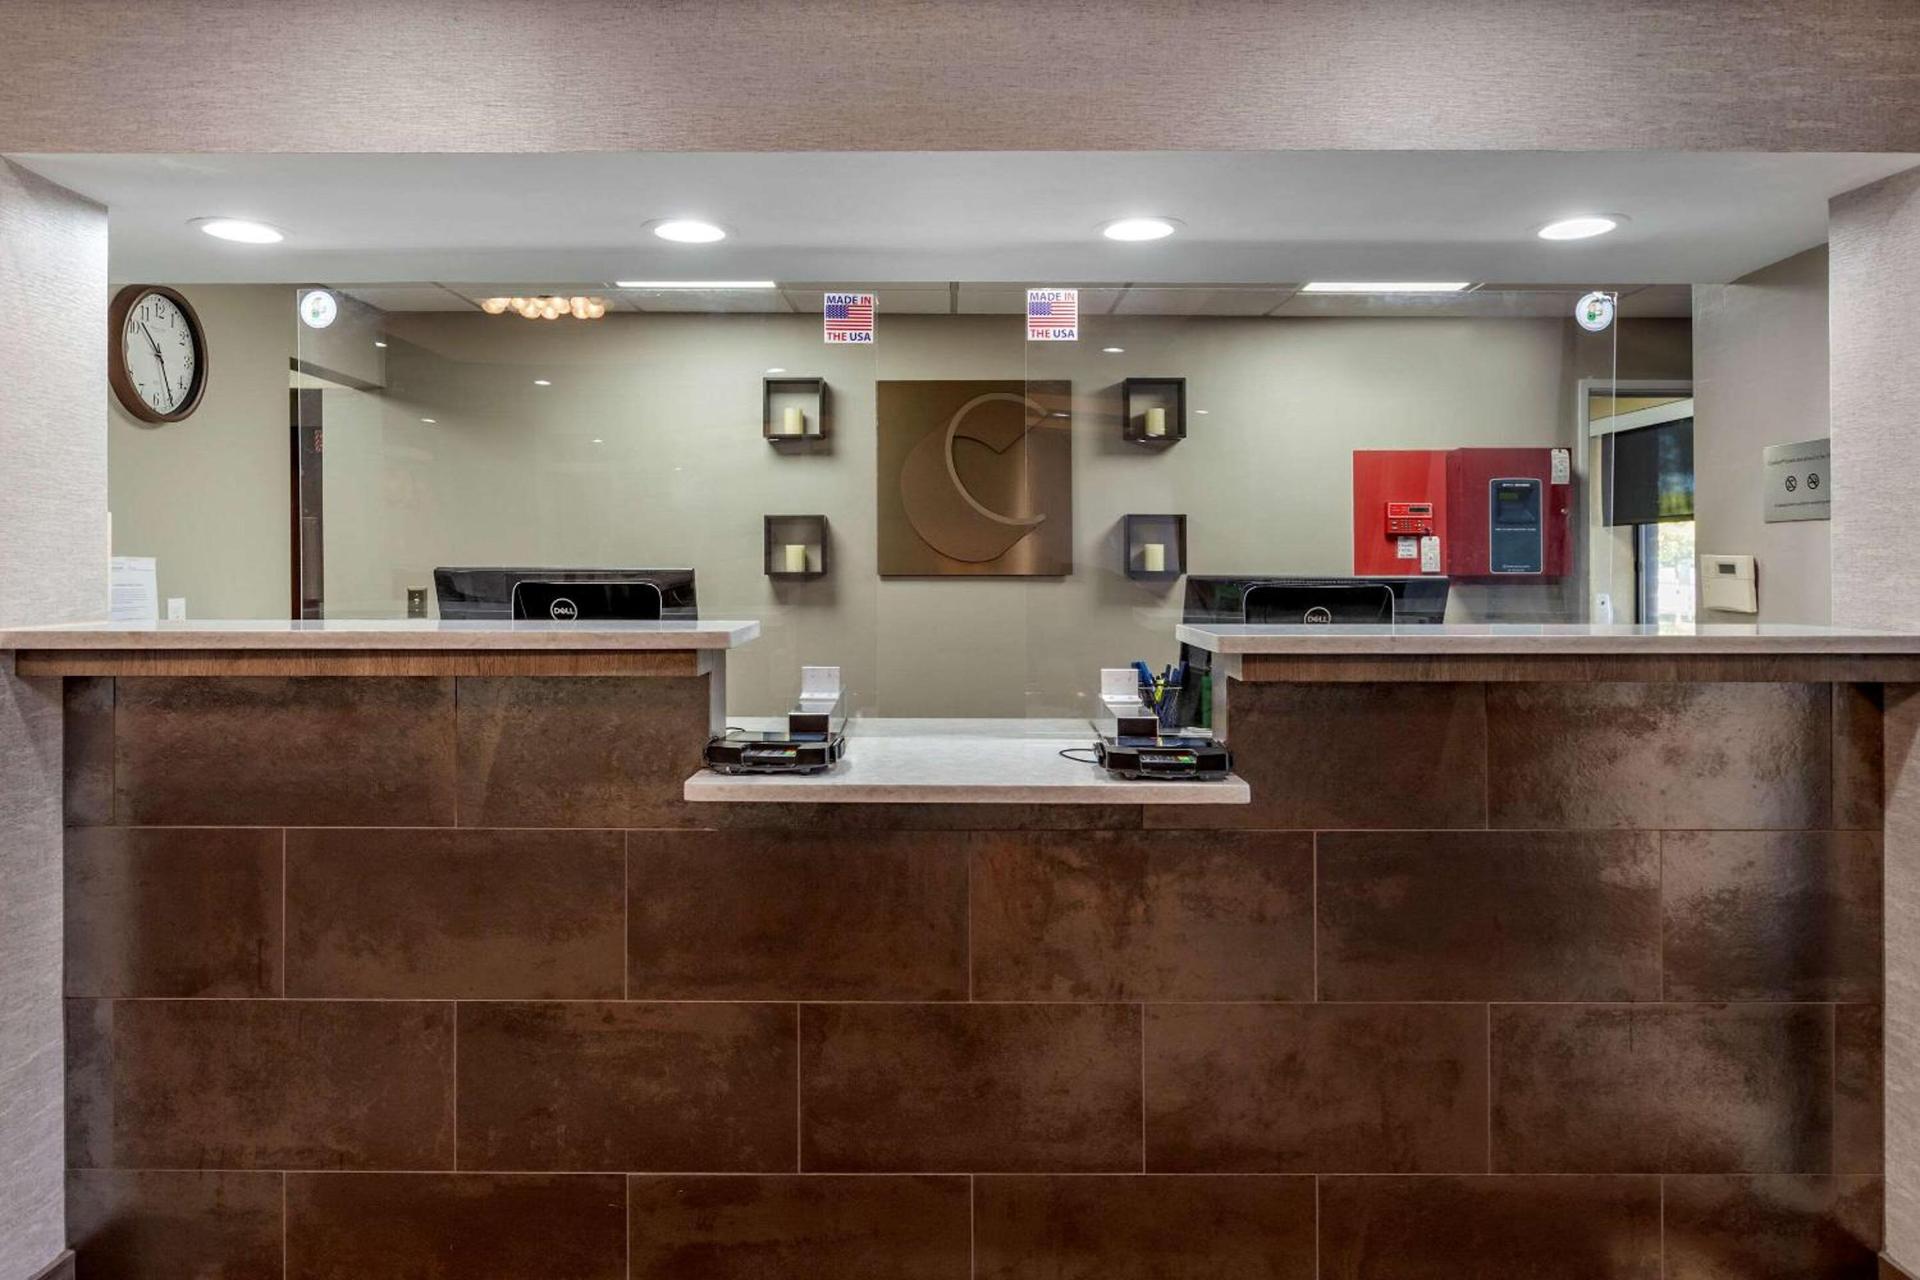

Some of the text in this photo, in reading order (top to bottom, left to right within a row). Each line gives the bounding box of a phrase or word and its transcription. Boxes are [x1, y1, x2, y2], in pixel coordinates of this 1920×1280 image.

[827, 296, 871, 304] MADE IN
[1030, 292, 1075, 301] MADE IN
[141, 305, 149, 321] 11
[155, 303, 165, 319] 12
[827, 332, 871, 341] THE USA
[1030, 329, 1075, 338] THE USA
[153, 392, 160, 406] 6
[554, 607, 575, 615] DELL
[1308, 615, 1329, 623] DELL
